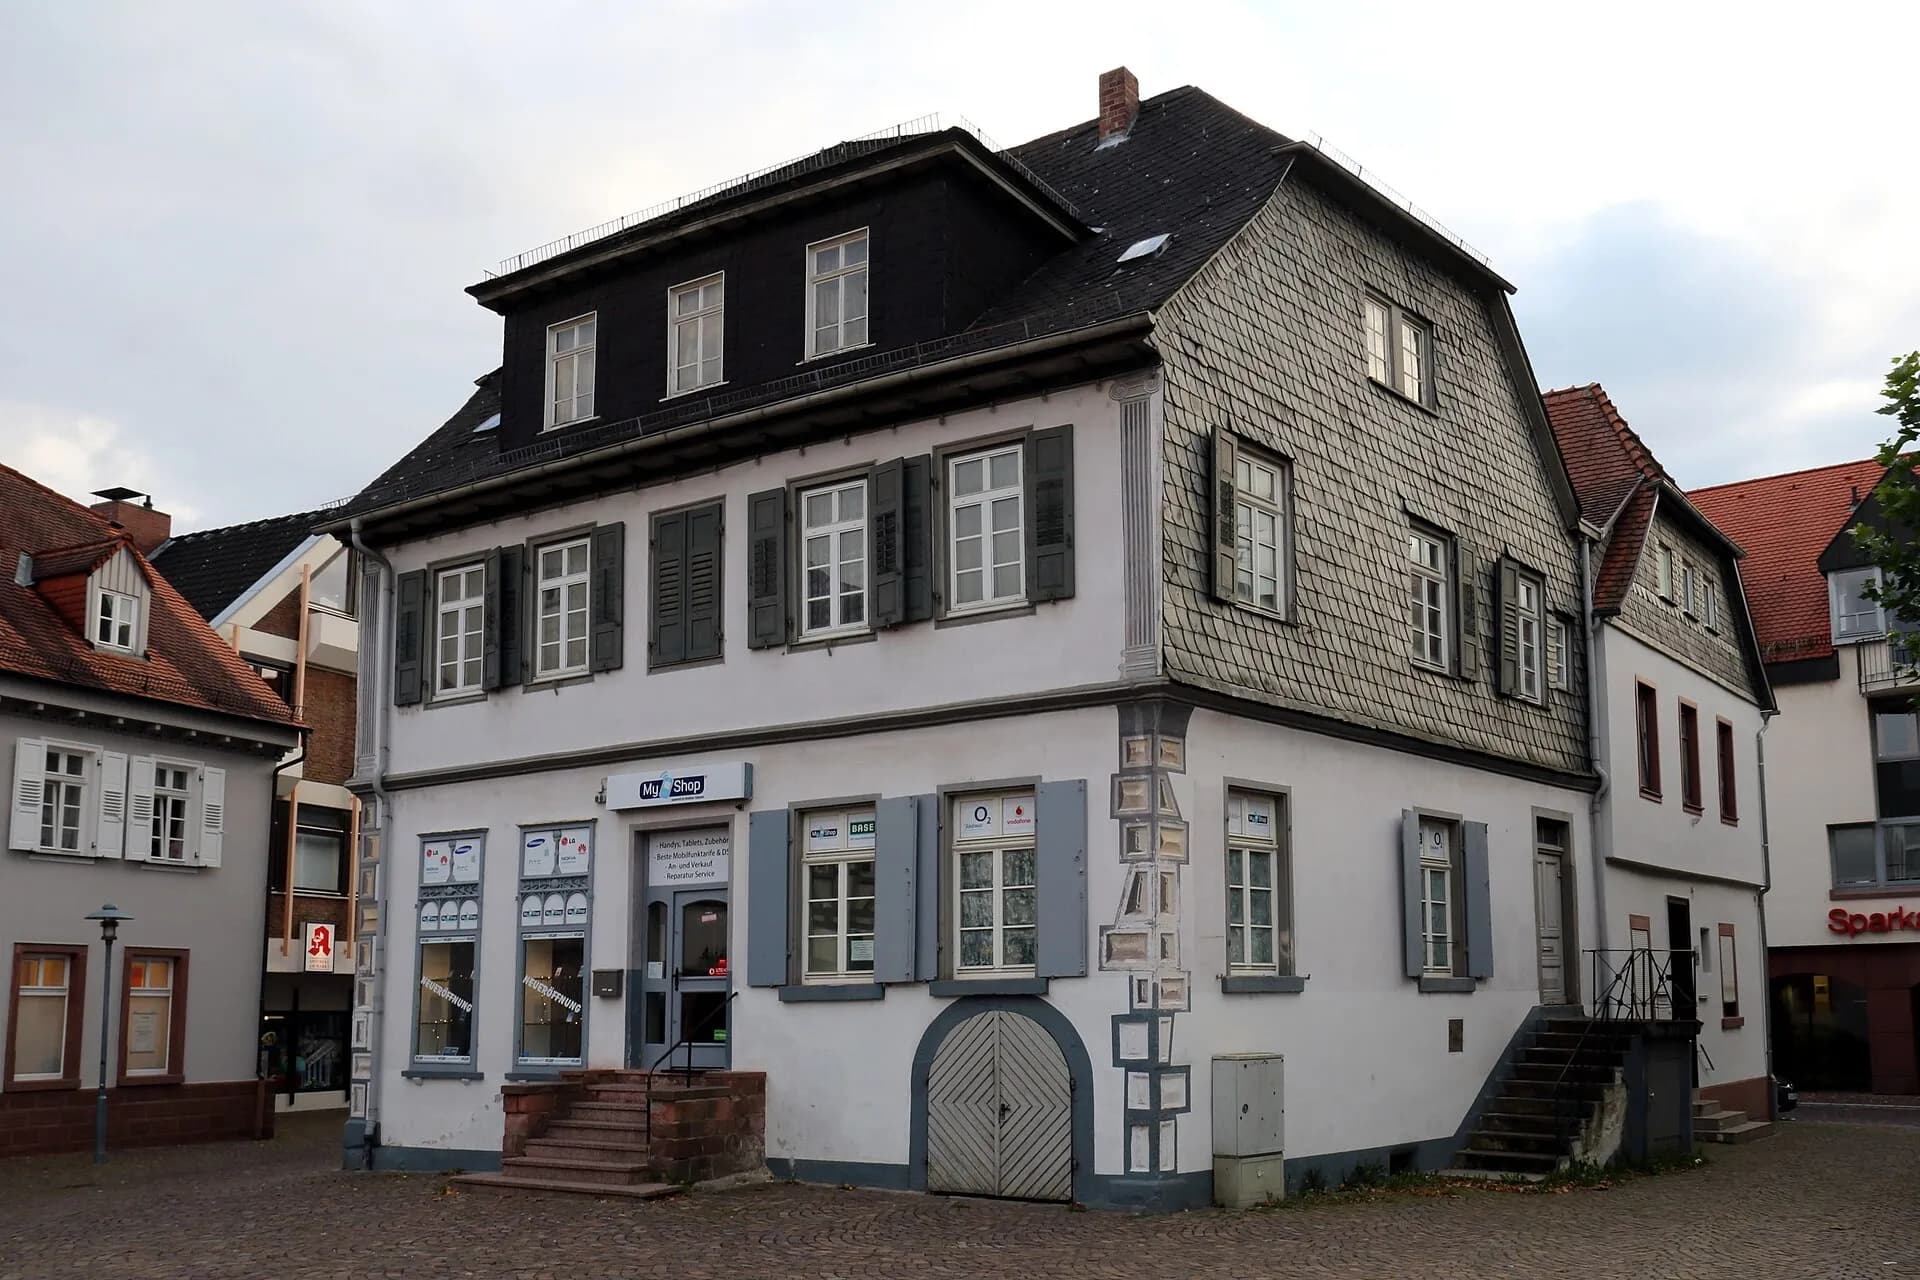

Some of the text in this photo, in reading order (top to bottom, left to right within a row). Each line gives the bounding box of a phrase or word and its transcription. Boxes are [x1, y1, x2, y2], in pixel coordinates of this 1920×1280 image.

[643, 780, 701, 797] My Shop
[852, 823, 874, 833] BASE
[656, 853, 672, 861] Beste
[672, 848, 715, 859] Mobilfunktarife
[716, 848, 721, 856] &
[679, 861, 690, 869] und
[690, 860, 713, 868] Verkauf
[666, 871, 694, 880] Reparatur
[694, 870, 715, 878] Service
[1828, 906, 1920, 939] Spark
[421, 975, 473, 1012] NEUERÖFFNUNG
[522, 975, 582, 1013] NEUERÖFFNUNG
